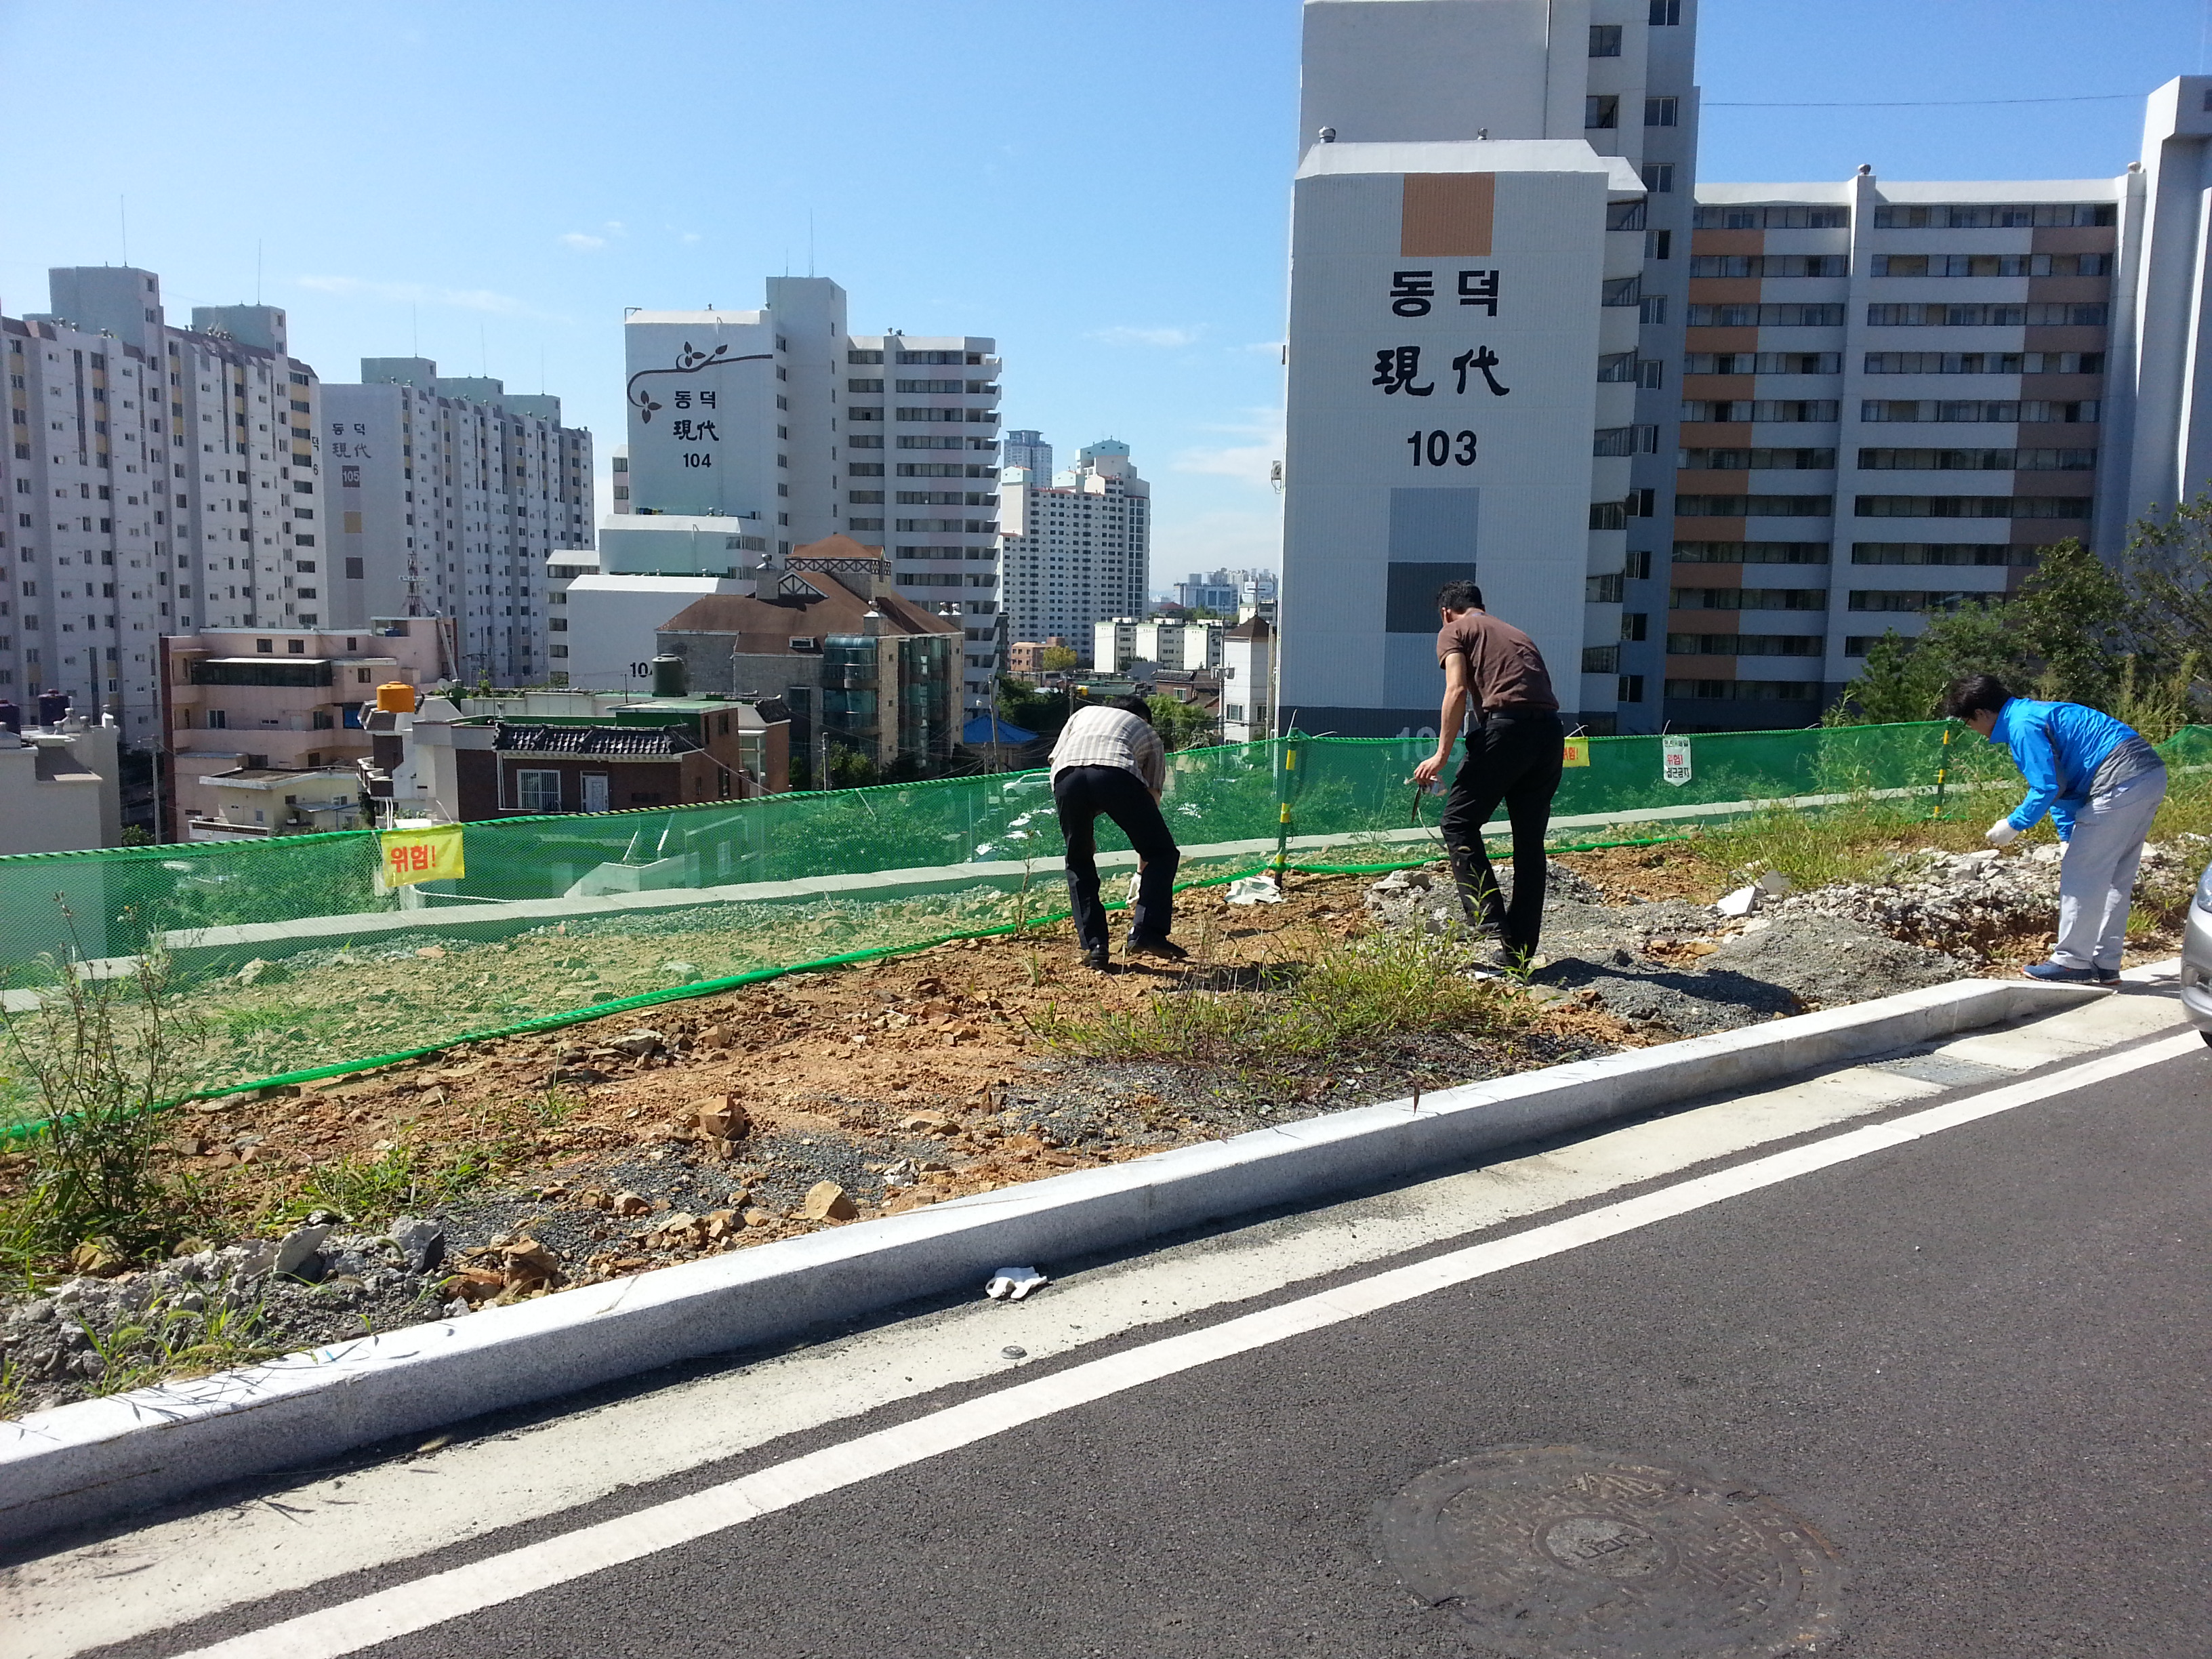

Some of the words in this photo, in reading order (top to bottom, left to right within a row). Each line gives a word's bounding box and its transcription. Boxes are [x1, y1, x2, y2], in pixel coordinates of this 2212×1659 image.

[1390, 270, 1499, 317] 동덕
[1372, 345, 1510, 396] 現代
[674, 391, 716, 409] 동덕
[332, 423, 365, 436] 동덕
[673, 419, 719, 441] 現代
[332, 443, 371, 458] 現代
[1408, 430, 1477, 466] 103
[683, 453, 712, 468] 104
[343, 470, 359, 482] 105
[630, 662, 653, 678] 10
[1667, 767, 1689, 779] 접근금지
[390, 844, 436, 873] 위험!
